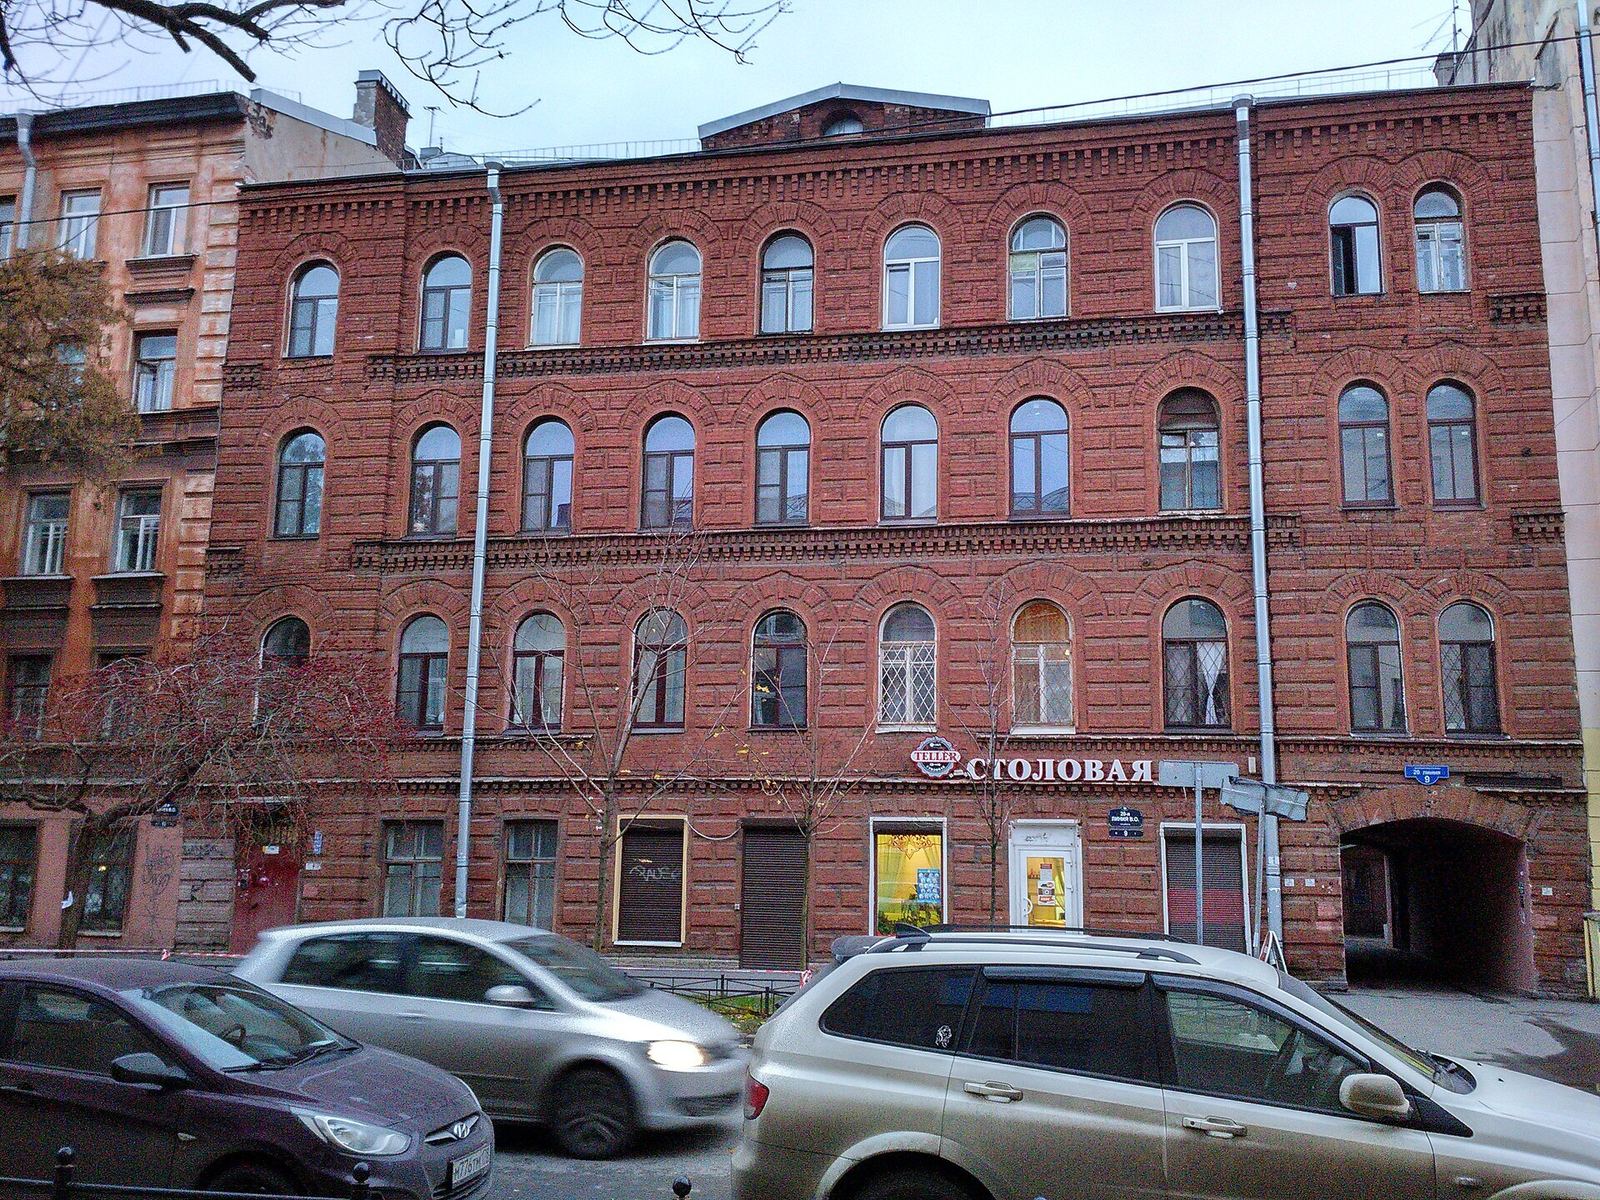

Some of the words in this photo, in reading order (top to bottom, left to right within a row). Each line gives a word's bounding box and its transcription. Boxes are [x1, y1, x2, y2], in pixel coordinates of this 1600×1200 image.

[914, 752, 957, 761] TELLER
[966, 758, 1153, 782] СТОЛОВАЯ
[1424, 775, 1430, 783] 9
